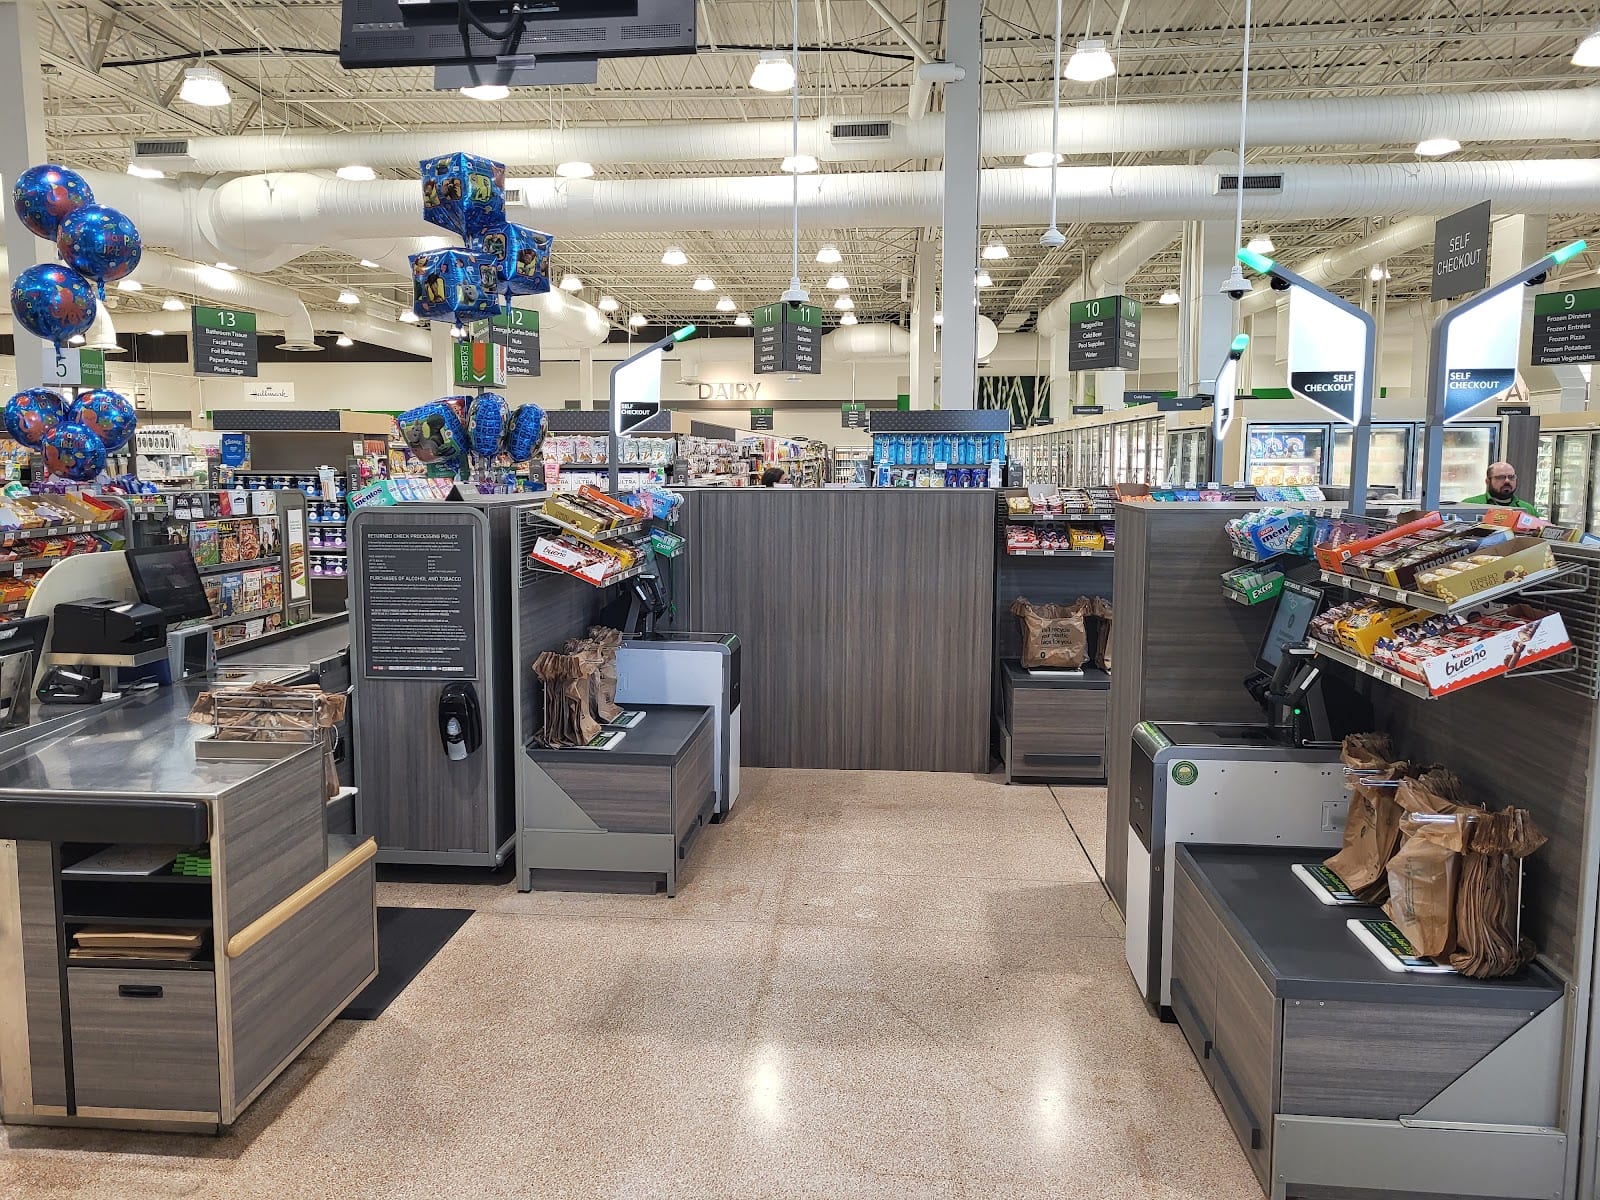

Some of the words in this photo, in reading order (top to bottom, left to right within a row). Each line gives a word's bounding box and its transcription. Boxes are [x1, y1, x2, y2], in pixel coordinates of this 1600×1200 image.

[1449, 232, 1471, 252] SELF
[1437, 248, 1482, 276] CHECKOUT
[1564, 293, 1576, 310] 9
[510, 310, 524, 326] 12
[764, 307, 772, 323] 11
[800, 307, 810, 323] 11
[1085, 302, 1100, 318] 10
[217, 311, 236, 327] 13
[205, 328, 232, 336] Bathroom
[212, 338, 227, 346] Facial
[228, 340, 244, 348] Tissue
[209, 356, 224, 364] Paper
[225, 357, 248, 365] Products
[461, 345, 469, 381] EXPRESS
[1561, 354, 1596, 362] Vegetables
[56, 356, 67, 378] 5
[231, 367, 244, 375] Bags
[1333, 374, 1354, 382] SELF
[1449, 372, 1471, 380] SELF
[698, 382, 761, 400] DAIRY
[1304, 383, 1354, 392] CHECKOUT
[1449, 381, 1500, 389] CHECKOUT
[621, 408, 651, 416] CHECKOUT
[354, 487, 383, 507] mentos
[542, 546, 566, 558] bueno
[1252, 582, 1273, 599] Extra
[1445, 649, 1486, 676] bueno
